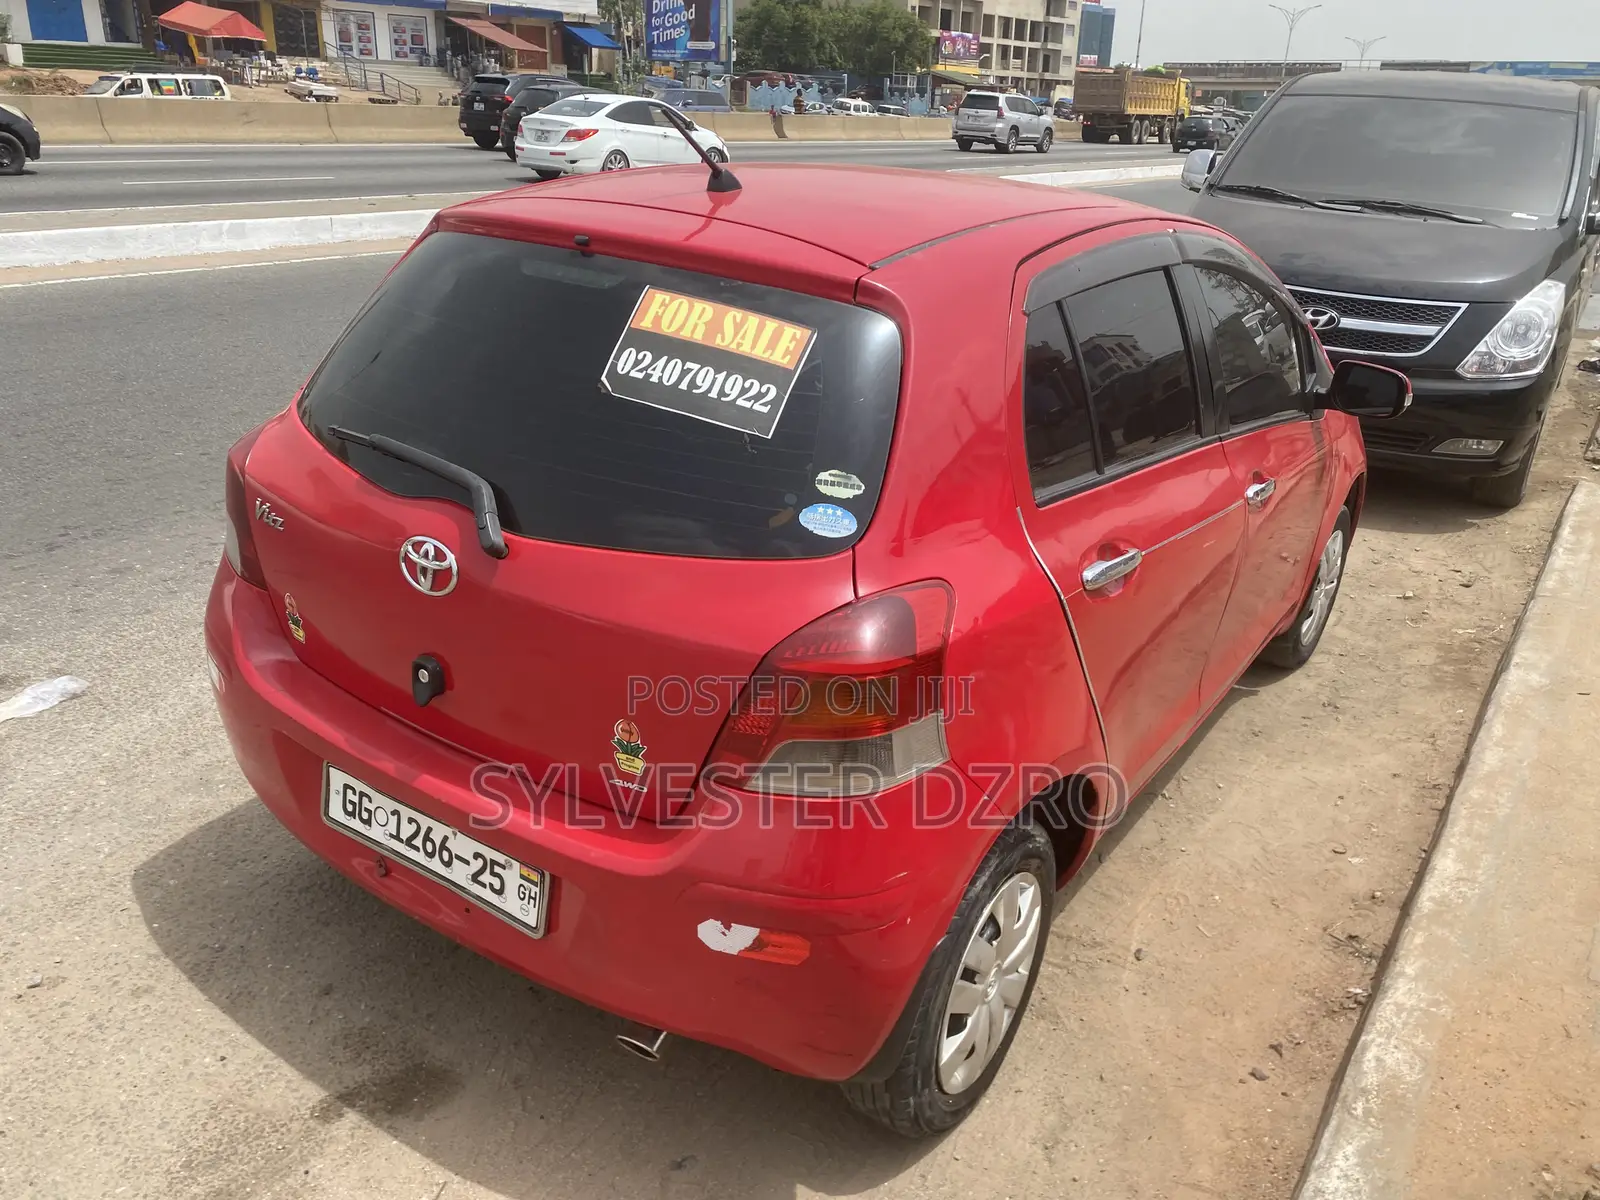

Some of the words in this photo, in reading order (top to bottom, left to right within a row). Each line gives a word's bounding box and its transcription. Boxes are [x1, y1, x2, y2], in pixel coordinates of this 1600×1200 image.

[651, 16, 664, 27] for
[664, 3, 696, 27] Good
[651, 25, 686, 45] Times
[640, 292, 713, 345] FOR
[716, 311, 802, 364] SALE
[616, 347, 778, 414] 0240791922
[255, 497, 285, 532] Vitz
[341, 782, 373, 828] GG
[389, 808, 508, 897] 1266-25
[517, 883, 538, 909] GH
